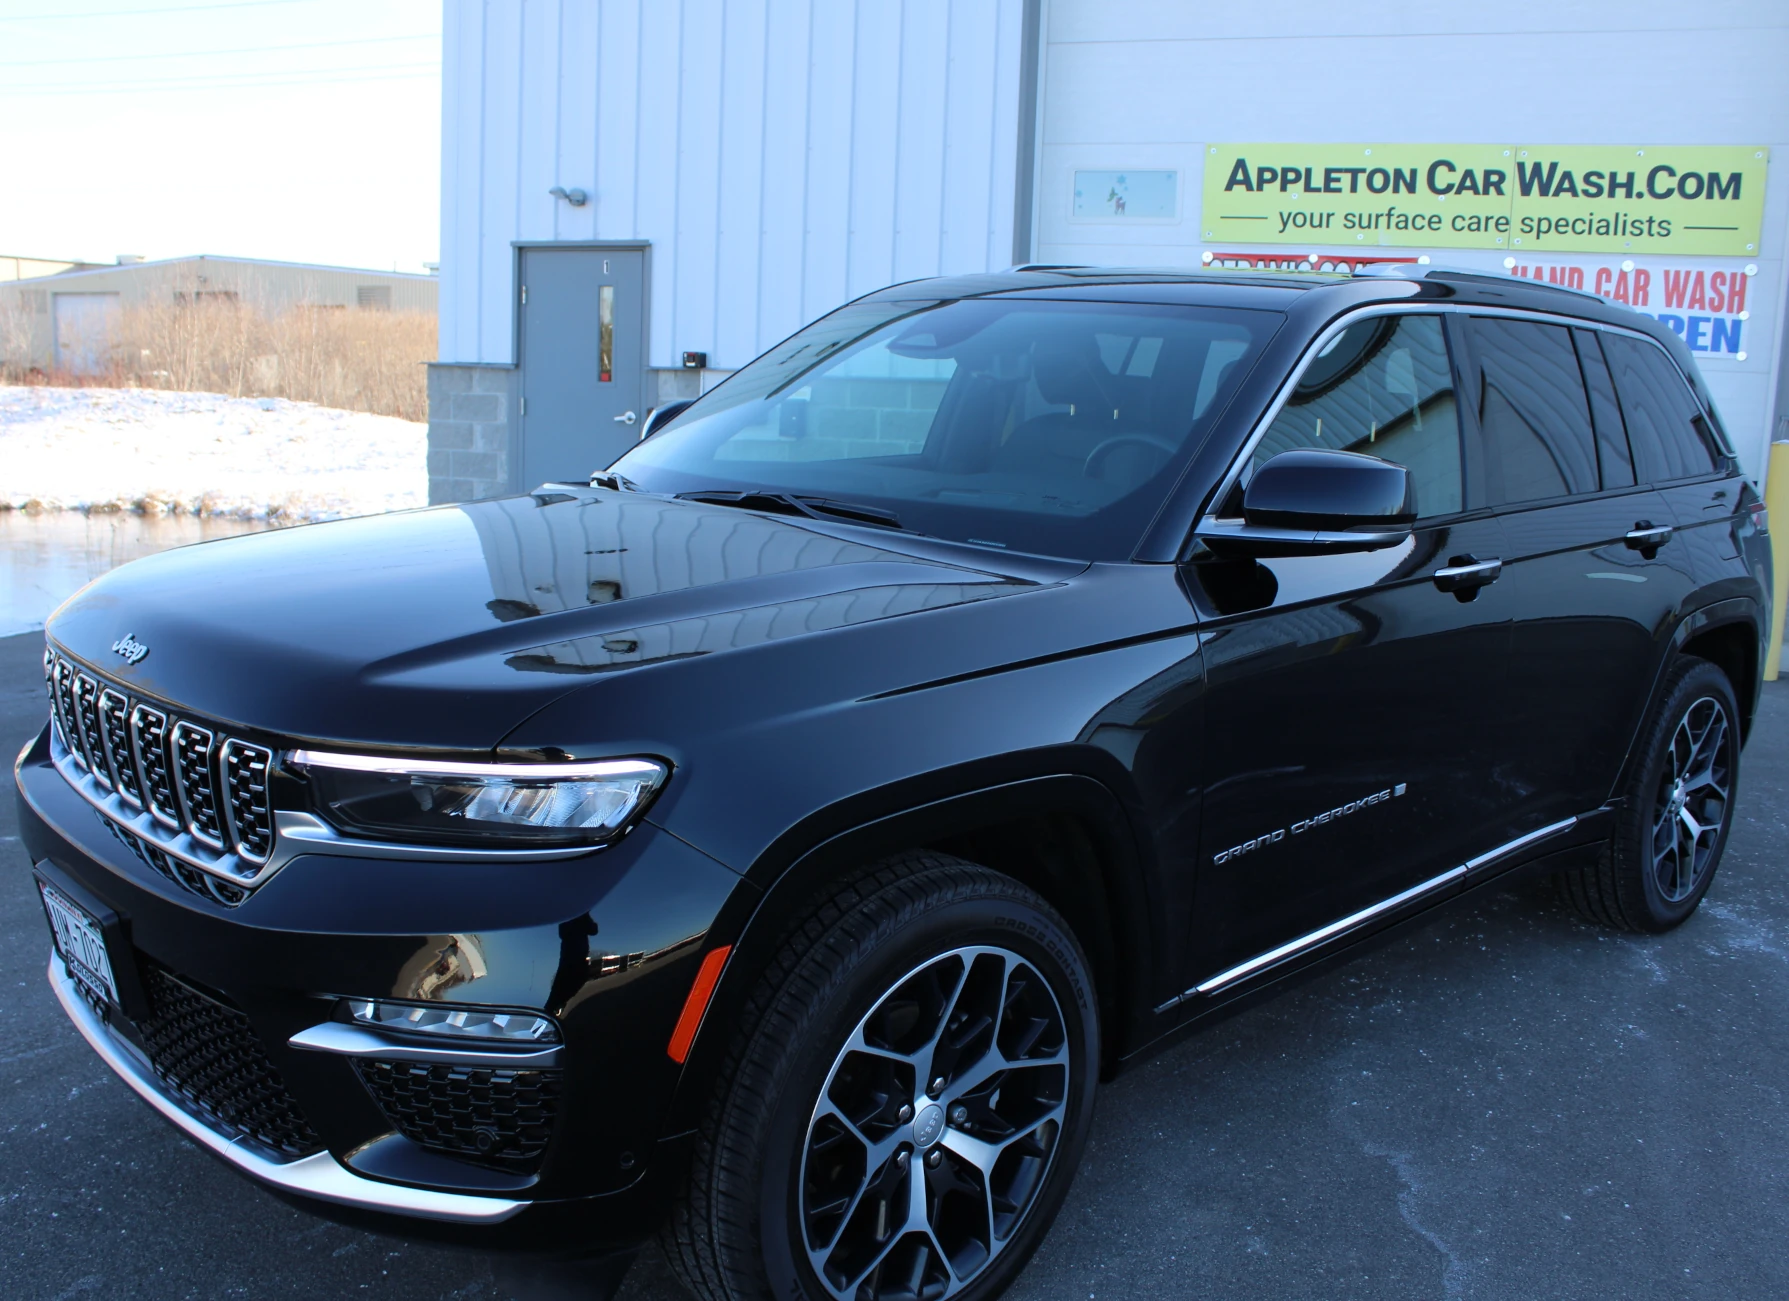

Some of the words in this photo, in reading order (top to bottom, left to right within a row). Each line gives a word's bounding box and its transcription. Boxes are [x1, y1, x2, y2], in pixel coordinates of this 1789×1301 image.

[1224, 158, 1418, 194] APPLETON
[1427, 159, 1506, 196] CAR
[1517, 161, 1742, 200] WASH.COM
[1278, 210, 1335, 233] your
[1343, 207, 1442, 231] surface
[1451, 213, 1510, 232] care
[1520, 212, 1673, 240] specialists
[1595, 267, 1651, 307] CAR
[1664, 269, 1747, 314] WASH
[1638, 313, 1742, 354] PEN
[112, 633, 149, 664] Jeep
[1213, 829, 1285, 866] GRAND
[1290, 789, 1391, 835] CHEROKEE
